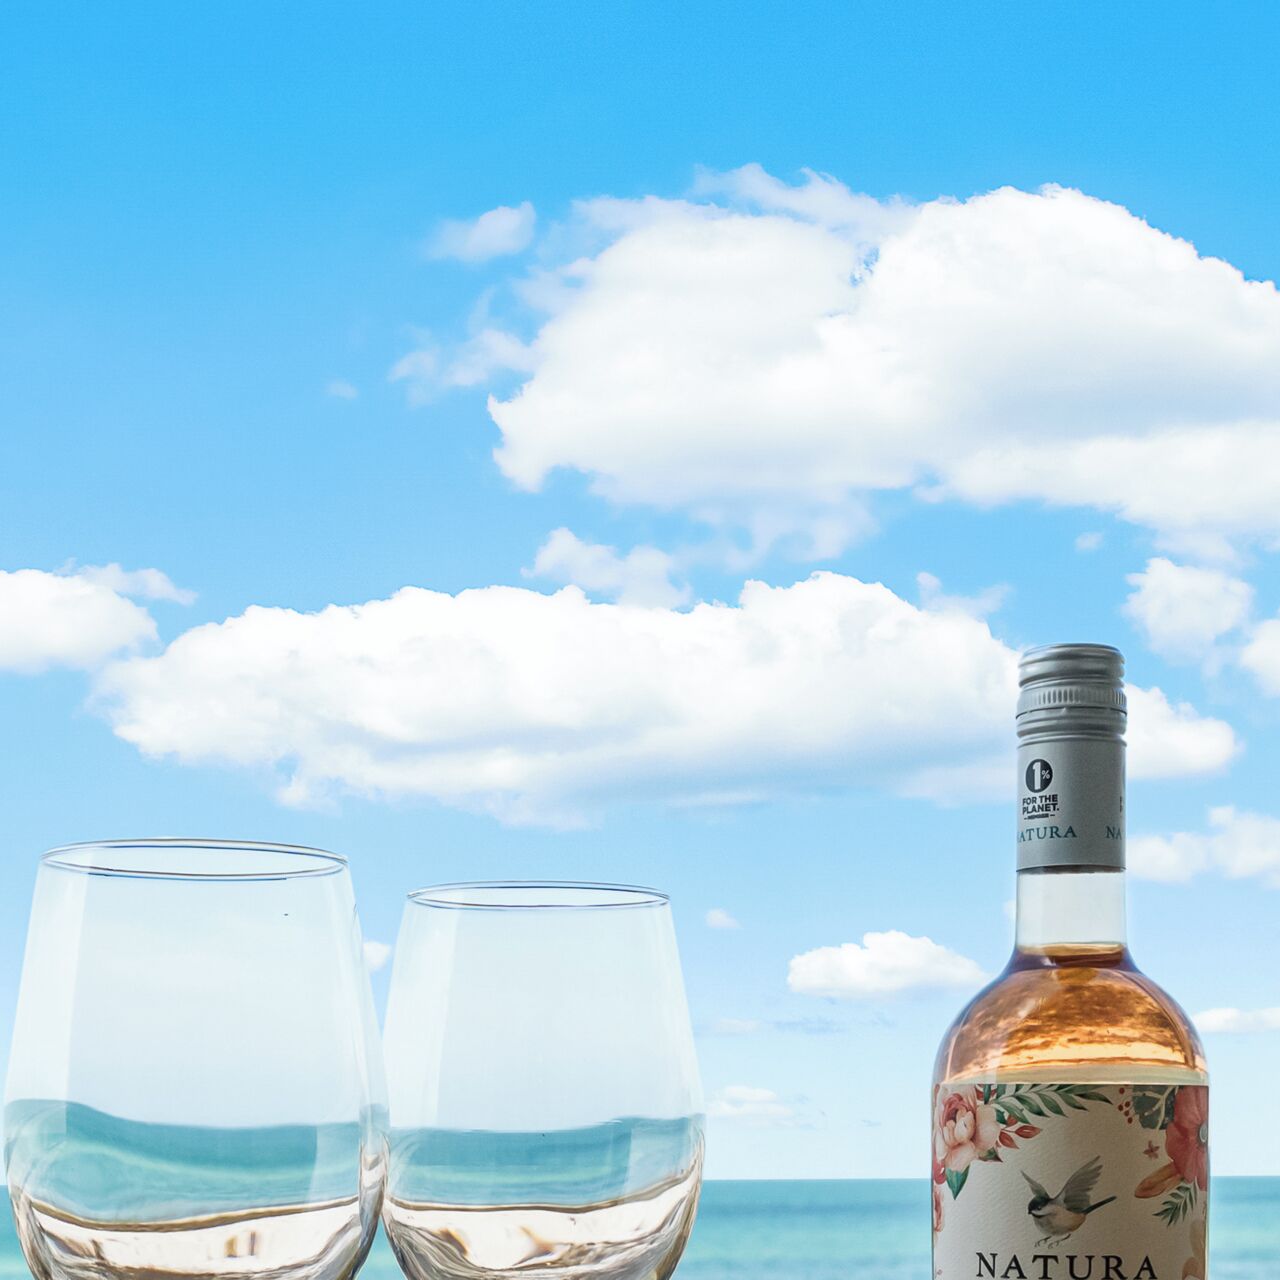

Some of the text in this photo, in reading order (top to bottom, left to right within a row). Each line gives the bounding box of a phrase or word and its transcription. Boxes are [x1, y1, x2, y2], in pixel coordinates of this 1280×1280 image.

[1031, 761, 1051, 791] 1%
[1022, 794, 1058, 806] FOR THE
[1022, 803, 1059, 815] PLANET.
[975, 1252, 1158, 1280] NATURA
